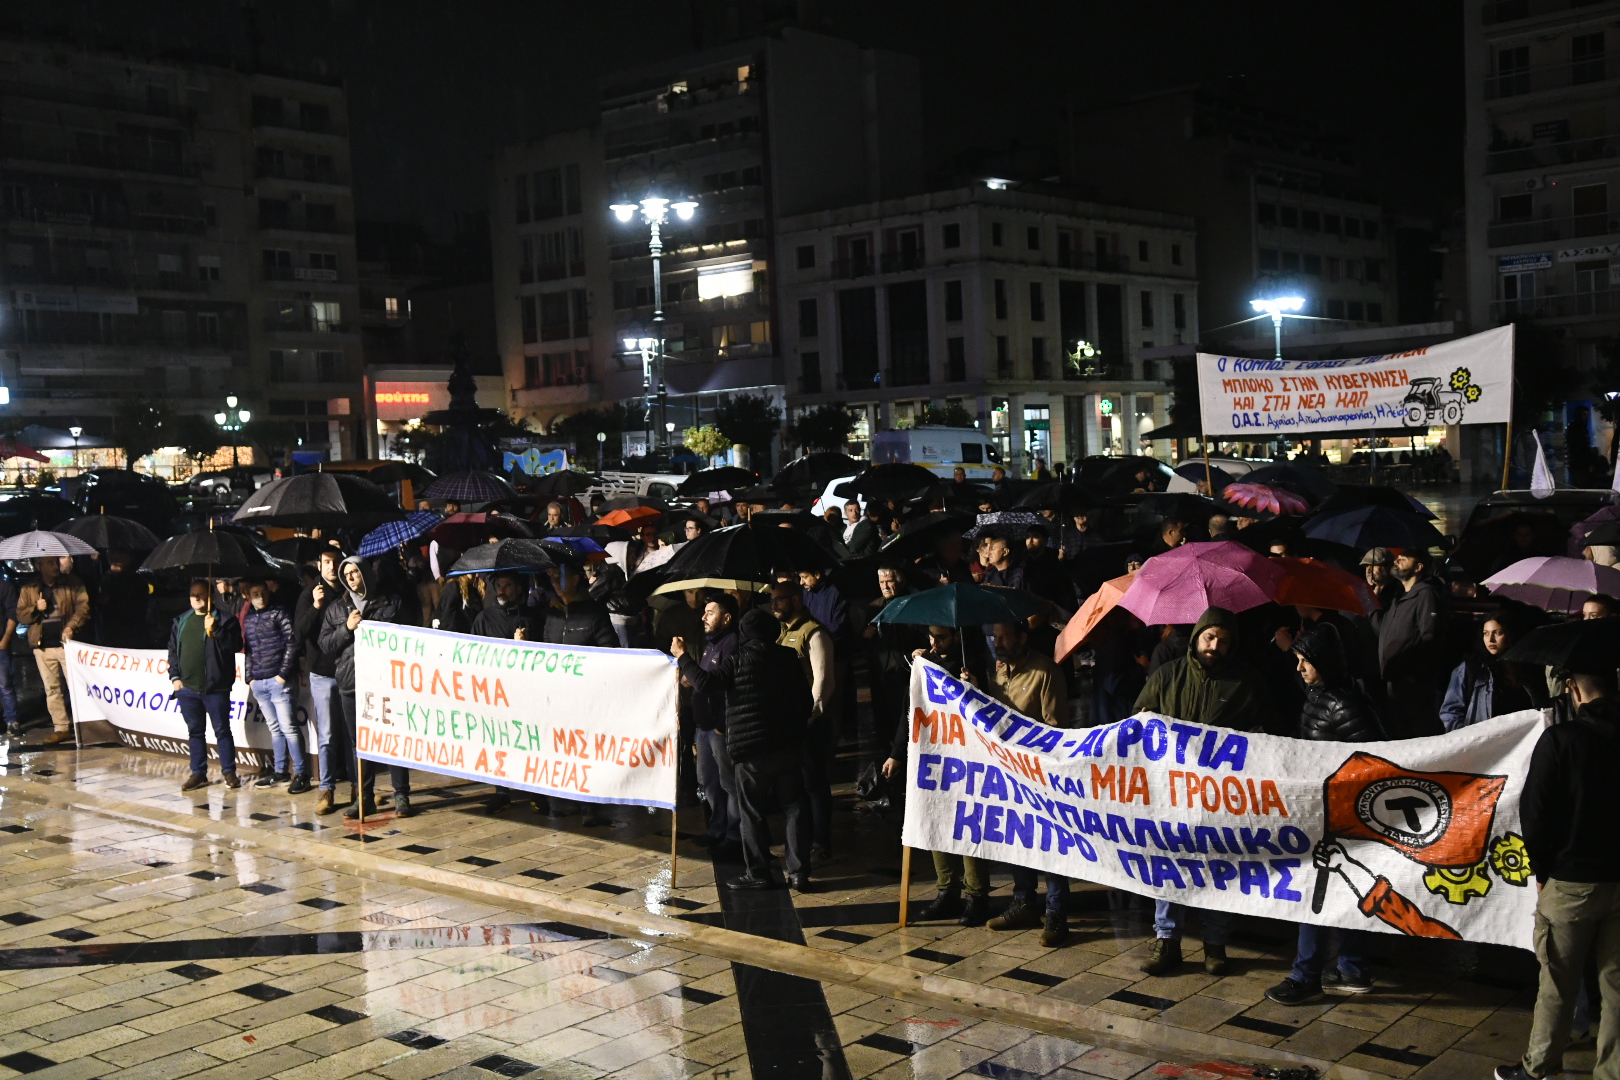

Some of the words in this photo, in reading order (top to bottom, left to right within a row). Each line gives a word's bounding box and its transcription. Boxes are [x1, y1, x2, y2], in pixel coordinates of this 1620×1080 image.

[1218, 358, 1226, 372] Ο
[1233, 357, 1290, 373] ΚΟΜΠΟΣ
[1222, 377, 1273, 394] ΜΠΛΟΚΟ
[1281, 374, 1318, 392] ΣΤΗΝ
[1324, 369, 1408, 390] ΚΥΒΕΡΝΗΣΗ
[1233, 396, 1254, 411] ΚΑΙ
[1263, 393, 1292, 412] ΣΤΗ
[1298, 392, 1326, 409] ΝΕΑ
[1335, 390, 1368, 408] ΚΑΠ
[359, 626, 425, 656] ΑΓΡΟΤΗ
[77, 649, 140, 672] ΜΕΙΩΣΗ
[390, 659, 510, 708] ΠΟΛΕΜΑ
[553, 727, 590, 759] ΜΑΣ
[523, 756, 592, 793] ΗΛΕΙΑΣ
[912, 706, 966, 747] ΜΙΑ
[1048, 772, 1086, 799] ΚΑΙ
[1090, 763, 1151, 806] ΜΙΑ
[1169, 770, 1289, 818] ΓΡΟΘΙΑ
[952, 801, 1098, 862] ΚΕΝΤΡΟ
[1118, 849, 1303, 902] ΠΑΤΡΑΣ
